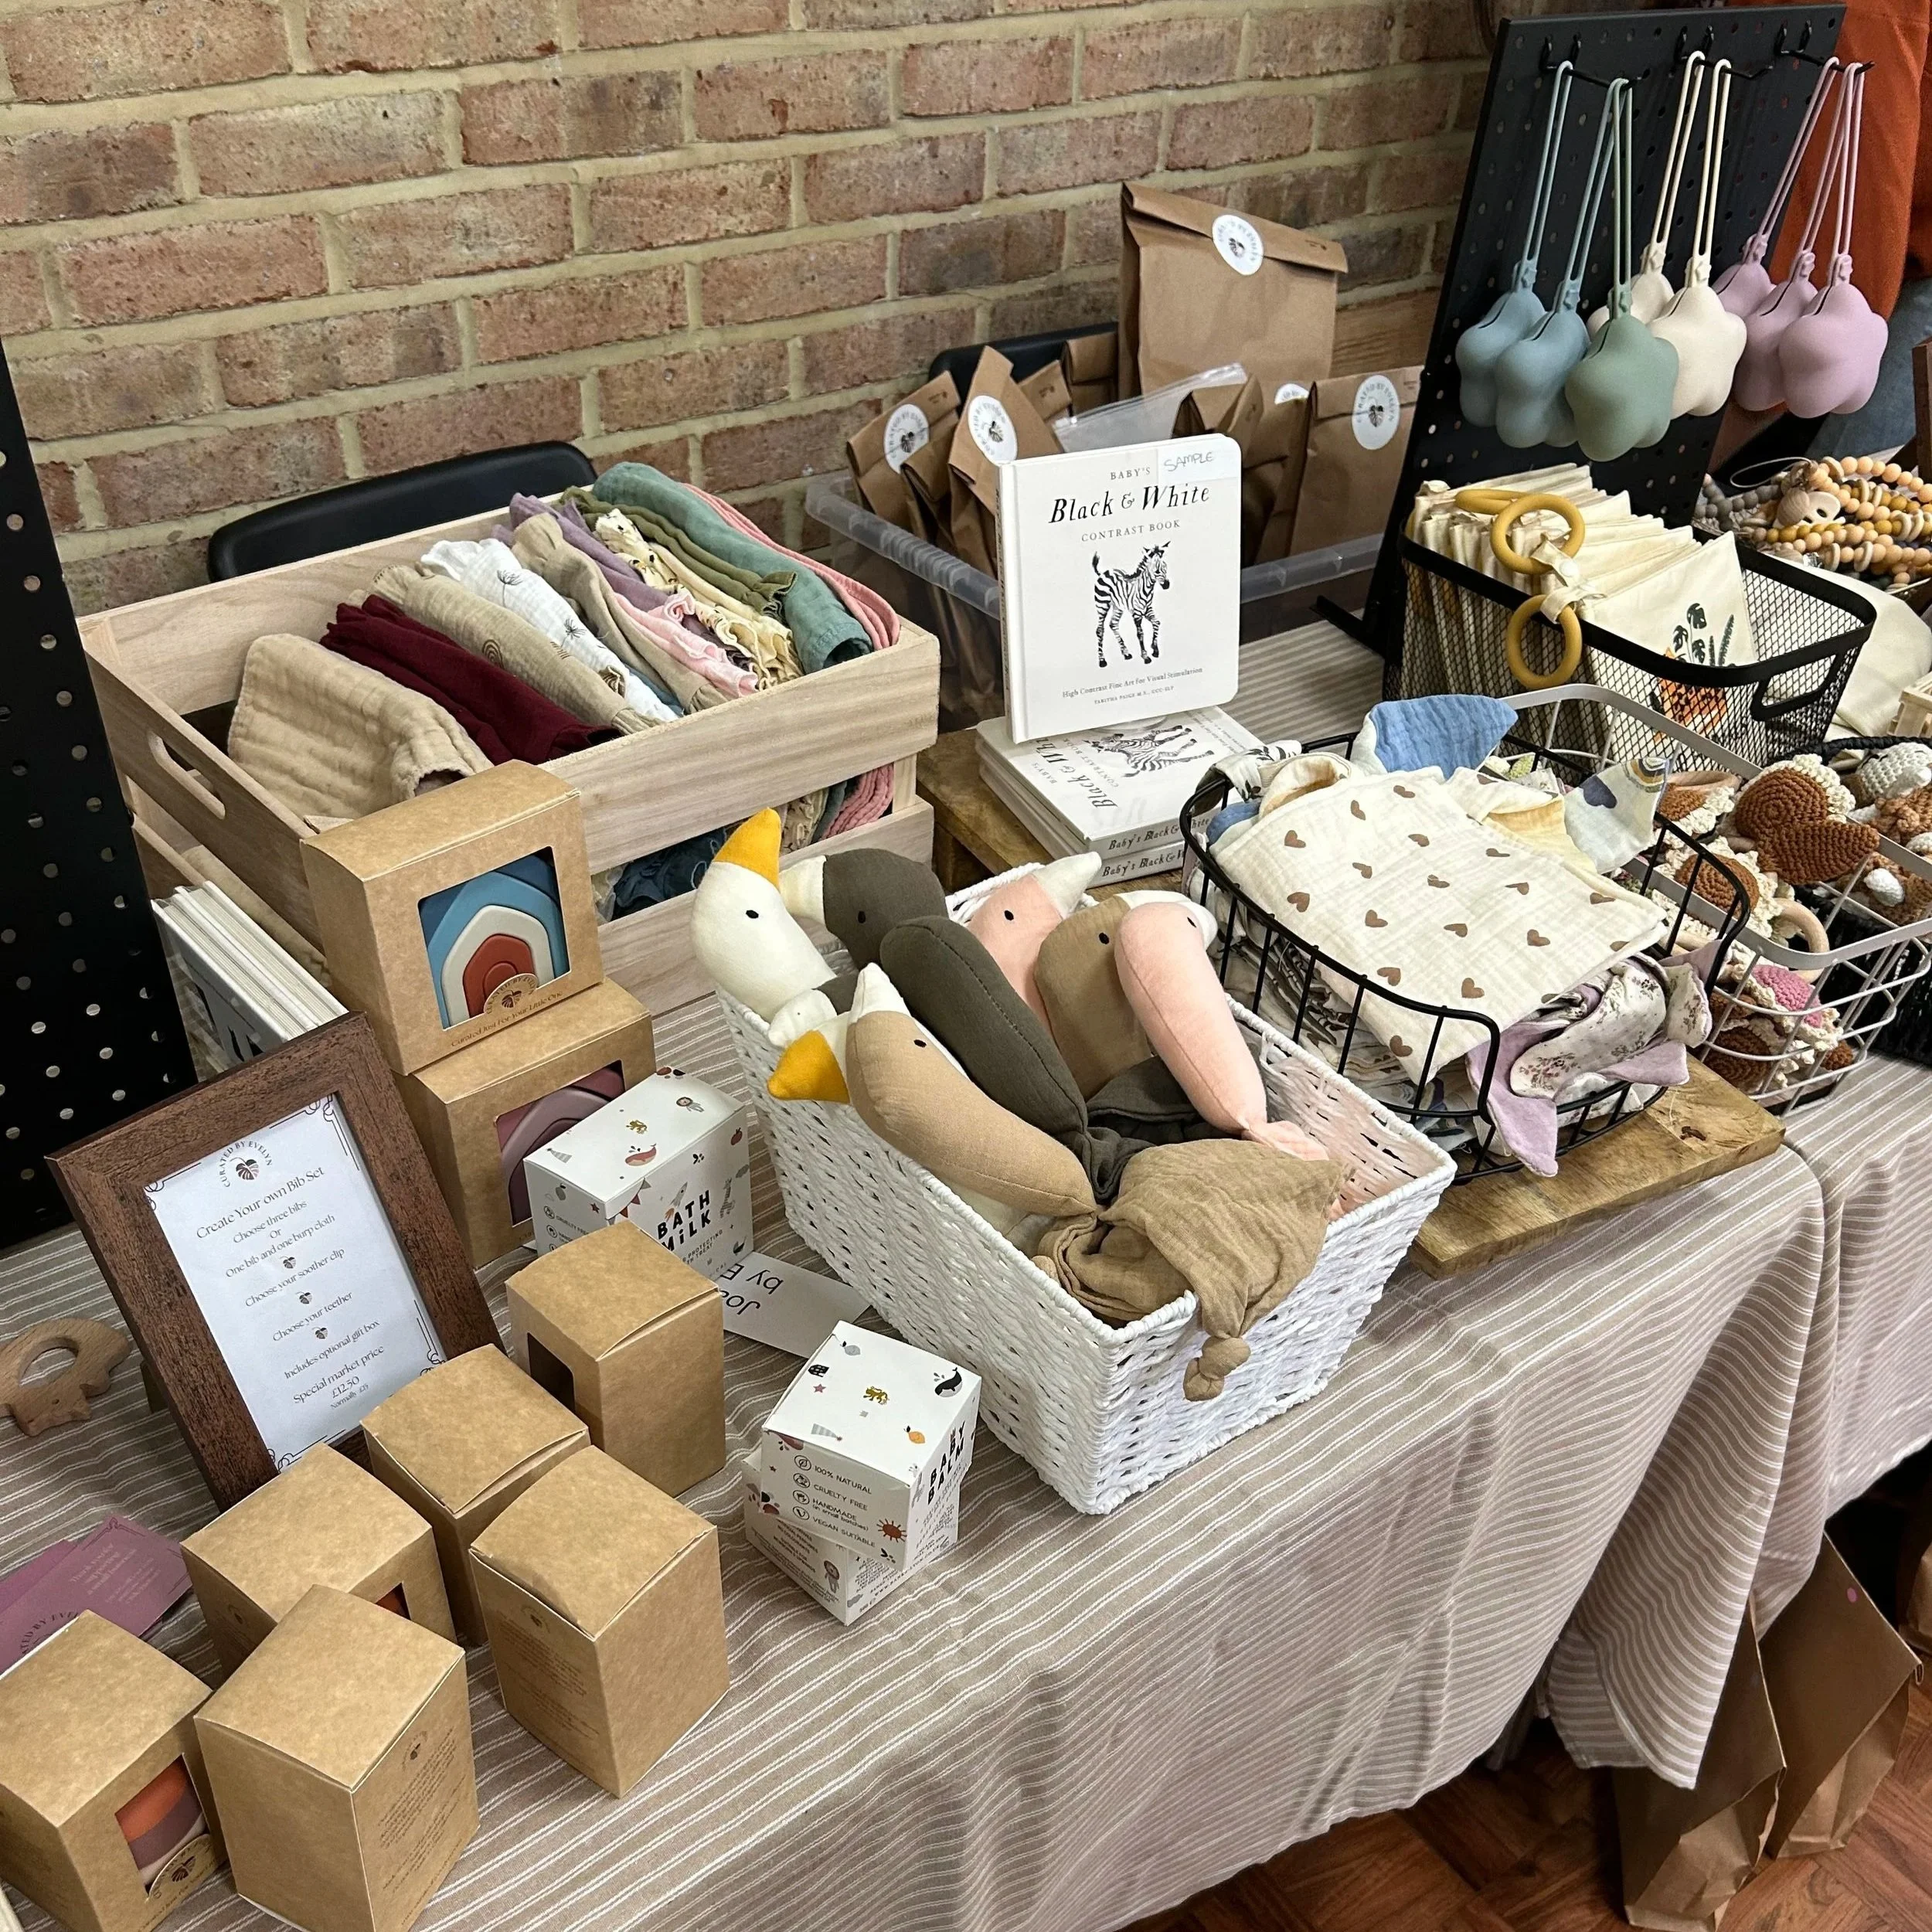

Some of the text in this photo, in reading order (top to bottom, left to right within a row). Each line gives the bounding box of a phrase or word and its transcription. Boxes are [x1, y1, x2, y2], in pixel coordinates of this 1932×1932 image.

[1111, 467, 1151, 480] BABY'S
[1164, 451, 1214, 471] SAMPLE
[1048, 483, 1209, 524] Black & White
[1081, 519, 1180, 542] CONTRAST BOOK
[1063, 689, 1079, 699] High
[1080, 685, 1107, 695] Contrast
[1108, 682, 1122, 690] Fine
[1147, 673, 1167, 682] Visual
[1167, 667, 1203, 679] Stimulation
[1067, 775, 1118, 808] Black
[1109, 835, 1141, 850] Baby's
[1144, 826, 1168, 842] Black
[1102, 861, 1135, 877] Baby's
[1139, 854, 1164, 868] Black
[451, 991, 563, 1046] Curated Just For Your Little One
[219, 1141, 273, 1188] CURATED BY EVELYN
[196, 1167, 325, 1239] Create Your own Bib Set
[233, 1200, 308, 1243] Choose three bibs
[657, 1189, 710, 1240] BATH
[226, 1213, 335, 1277] One bib and one burp cloth
[270, 1229, 281, 1239] Or
[245, 1248, 345, 1307] Choose your soother clip
[746, 1269, 784, 1294] by
[273, 1291, 352, 1342] Choose your teether
[284, 1320, 380, 1379] Includes optional gift box
[293, 1345, 385, 1404] Special market price
[928, 1437, 964, 1505] BALM
[930, 1420, 965, 1487] BABY
[814, 1484, 868, 1511] CRUELTY FREE
[815, 1465, 872, 1495] 100% NATURAL
[812, 1498, 856, 1521] HANDMADE
[812, 1516, 838, 1532] VEGAN
[841, 1529, 876, 1547] SUITABLE
